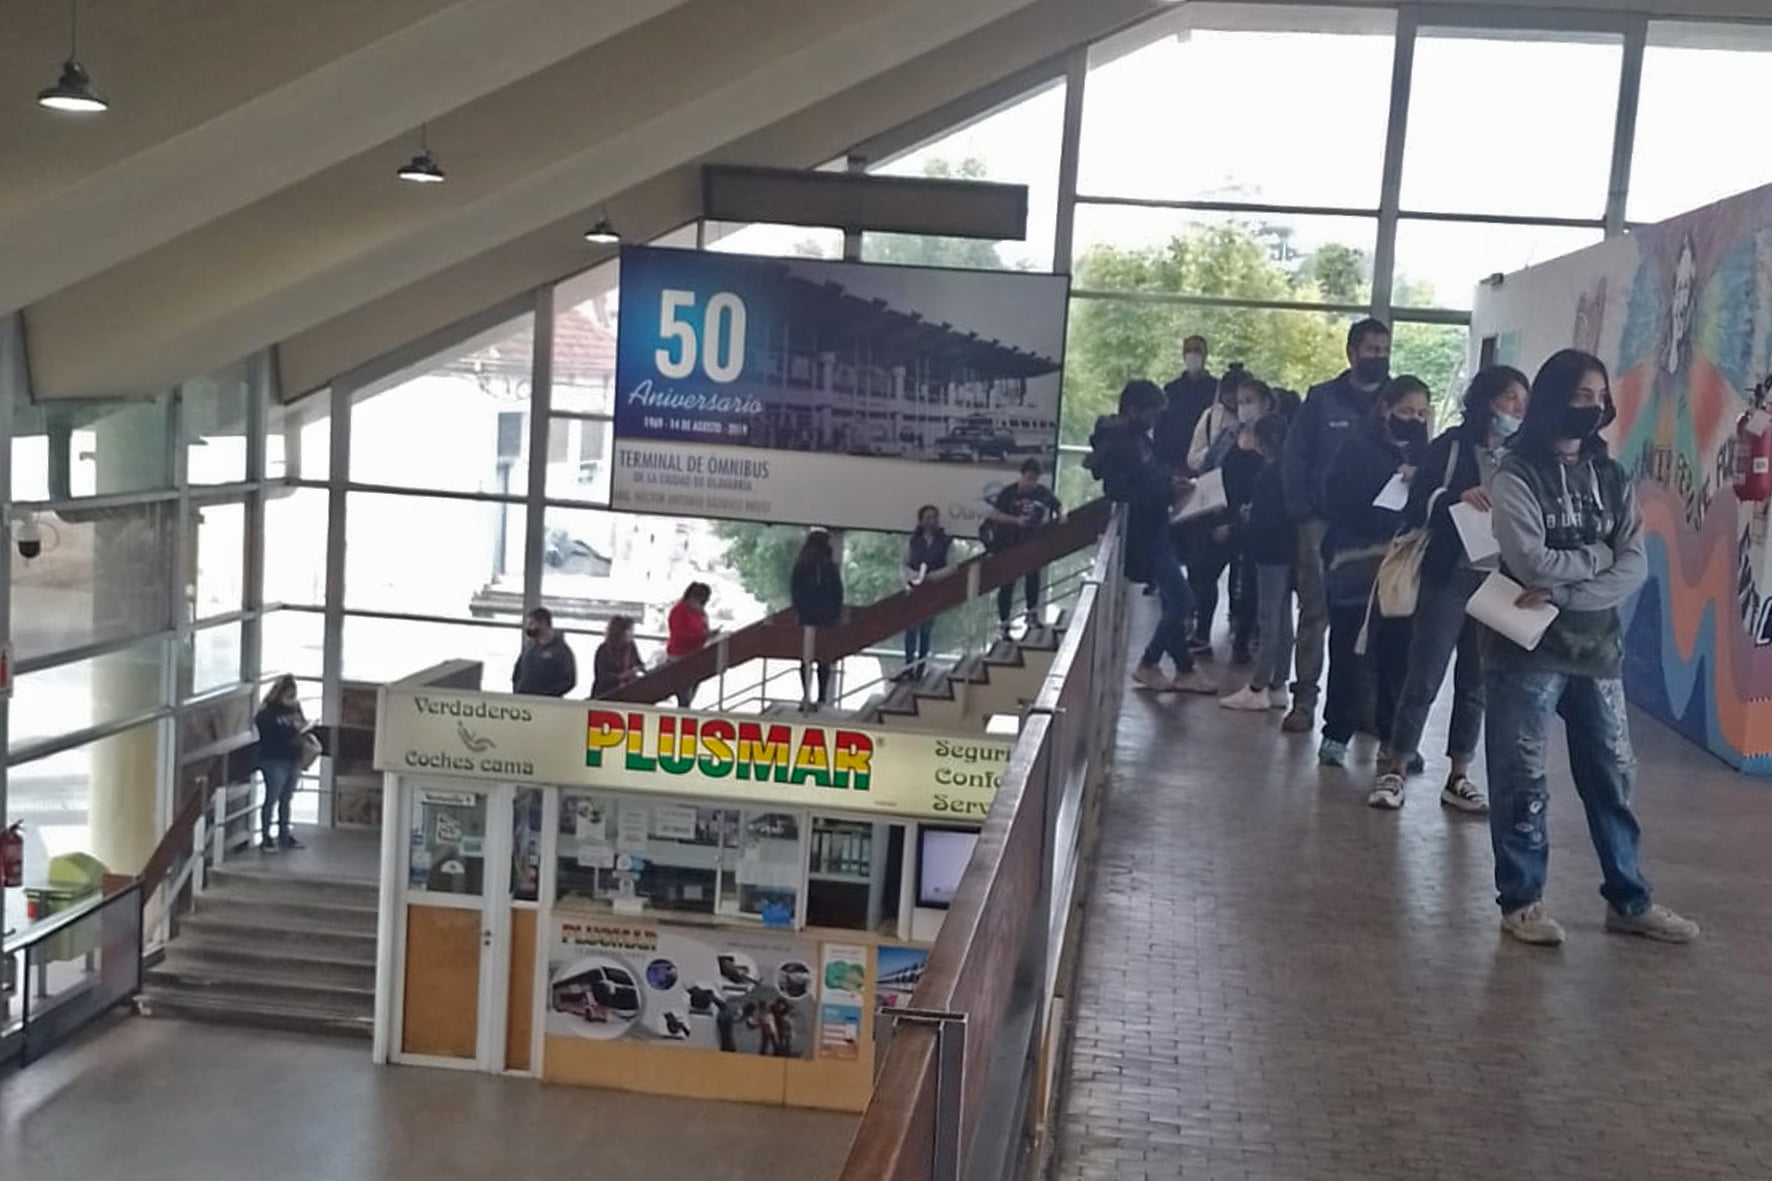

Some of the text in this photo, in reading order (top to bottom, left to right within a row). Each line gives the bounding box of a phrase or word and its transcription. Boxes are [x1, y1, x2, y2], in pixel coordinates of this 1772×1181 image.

[655, 289, 746, 383] 50
[628, 379, 763, 413] Aniversario
[620, 450, 683, 472] TERMINAL
[687, 456, 703, 474] DE
[414, 697, 532, 721] Verdaderos
[405, 750, 534, 775] Coches cama
[585, 709, 873, 791] PLUSMAR
